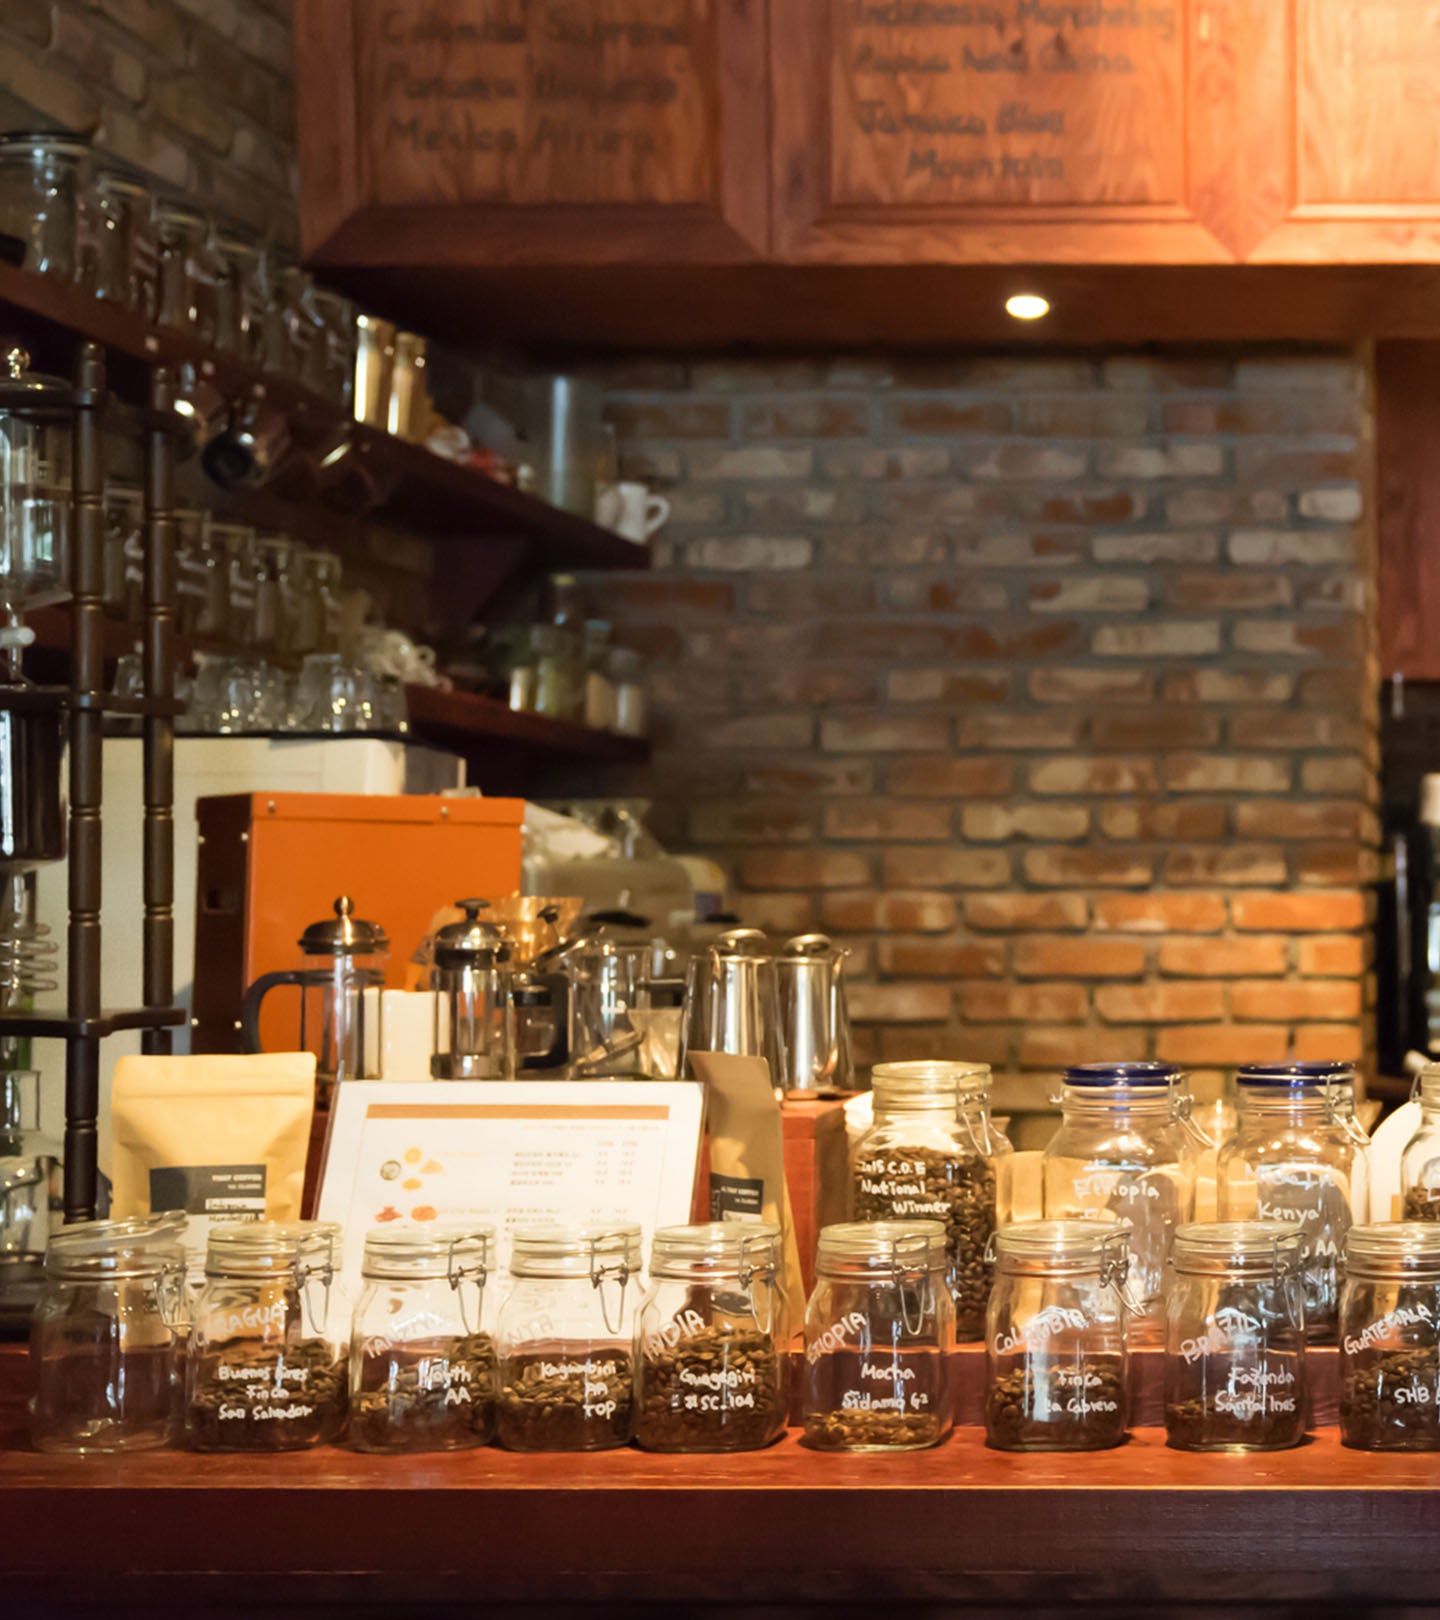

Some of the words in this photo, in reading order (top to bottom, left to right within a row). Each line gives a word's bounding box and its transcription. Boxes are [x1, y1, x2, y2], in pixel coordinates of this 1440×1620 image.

[1257, 1199, 1320, 1227] Kenya
[1343, 1302, 1433, 1355] GUATEMALA
[860, 1362, 915, 1380] Mocha
[444, 1386, 472, 1406] AA
[1393, 1386, 1430, 1405] SHB
